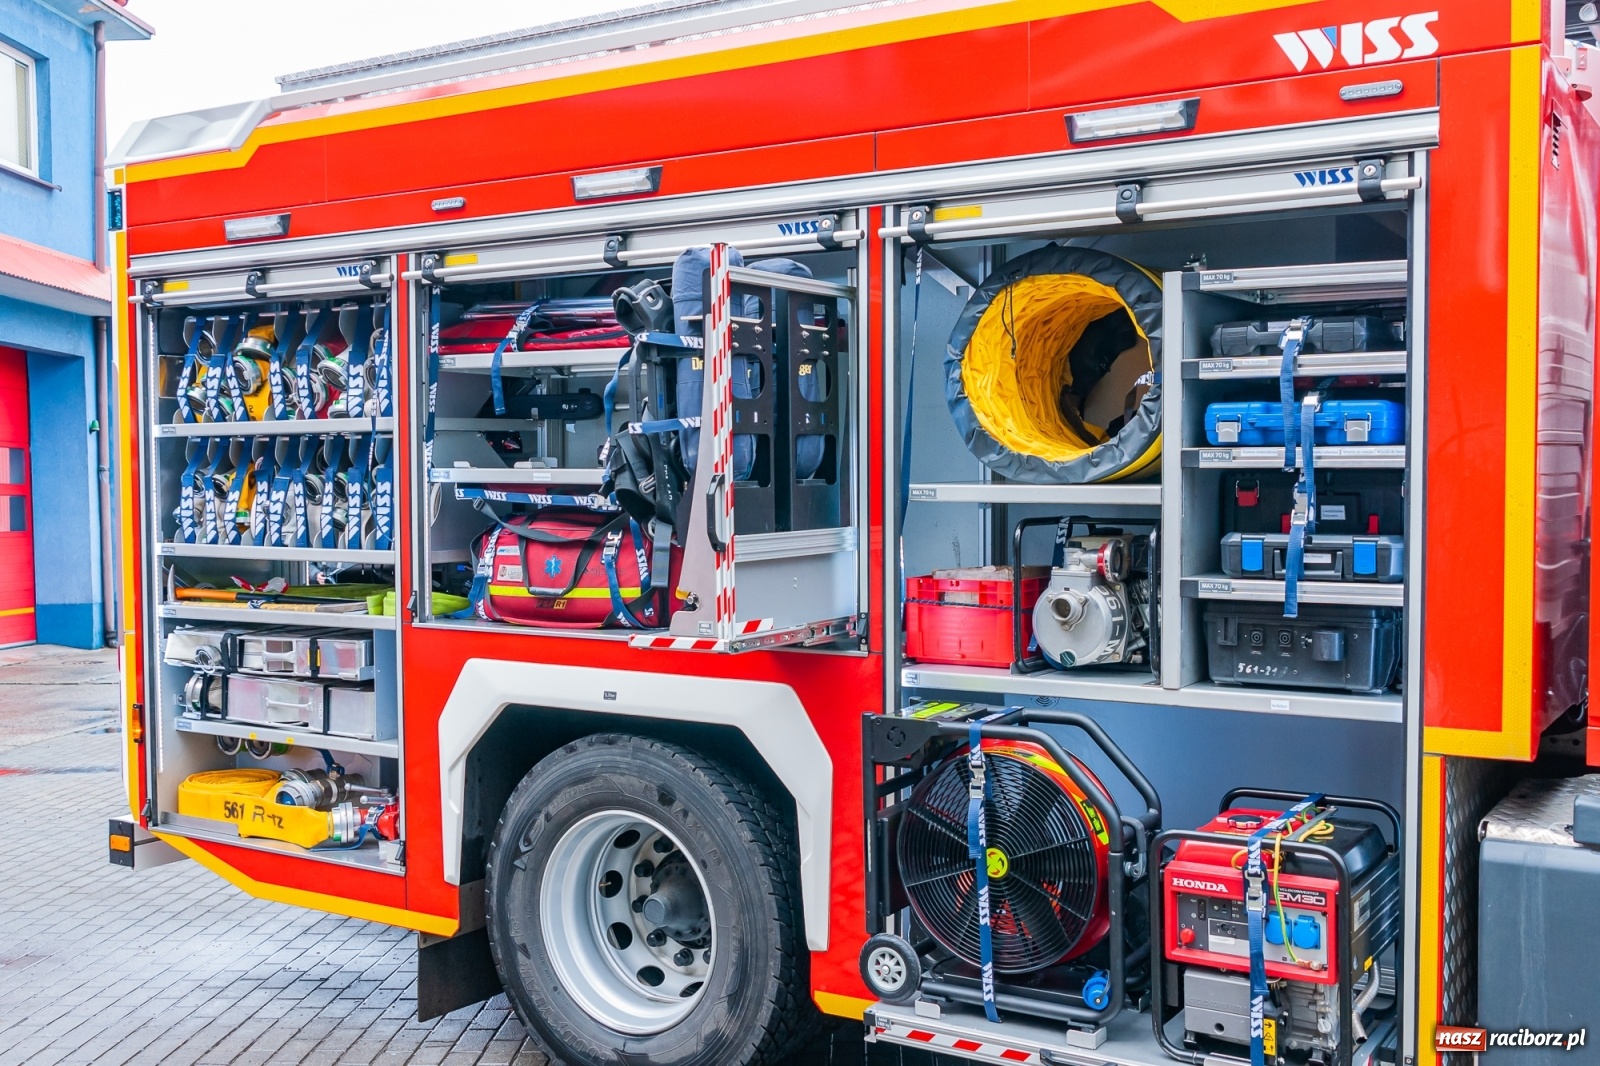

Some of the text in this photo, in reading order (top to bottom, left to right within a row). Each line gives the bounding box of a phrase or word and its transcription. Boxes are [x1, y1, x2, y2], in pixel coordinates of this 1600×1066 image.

[1272, 11, 1439, 73] WISS
[1294, 167, 1354, 187] WISS
[777, 221, 819, 236] WISS
[336, 265, 360, 277] WIS
[430, 322, 440, 354] WISS
[680, 335, 704, 349] WIS
[177, 366, 193, 419] WISS
[206, 366, 222, 419] WISS
[226, 364, 245, 421] WISS
[270, 360, 285, 418] WISS
[297, 363, 313, 419] WISS
[347, 364, 364, 418] WISS
[428, 382, 438, 413] WISS
[181, 486, 195, 540] WISS
[206, 489, 217, 543] WISS
[224, 490, 240, 543] WISS
[270, 490, 286, 544] WISS
[294, 483, 306, 540] WISS
[321, 481, 333, 539] WISS
[348, 482, 361, 541] WISS
[376, 481, 391, 540] WISS
[484, 490, 507, 501] WISS
[527, 494, 553, 504] WISS
[635, 548, 649, 581] WISS
[224, 800, 245, 820] 561
[978, 885, 991, 927] WISS
[1172, 877, 1229, 893] HONDA
[1277, 892, 1326, 906] EM30
[982, 961, 994, 1002] WISS
[1250, 995, 1264, 1039] WISS
